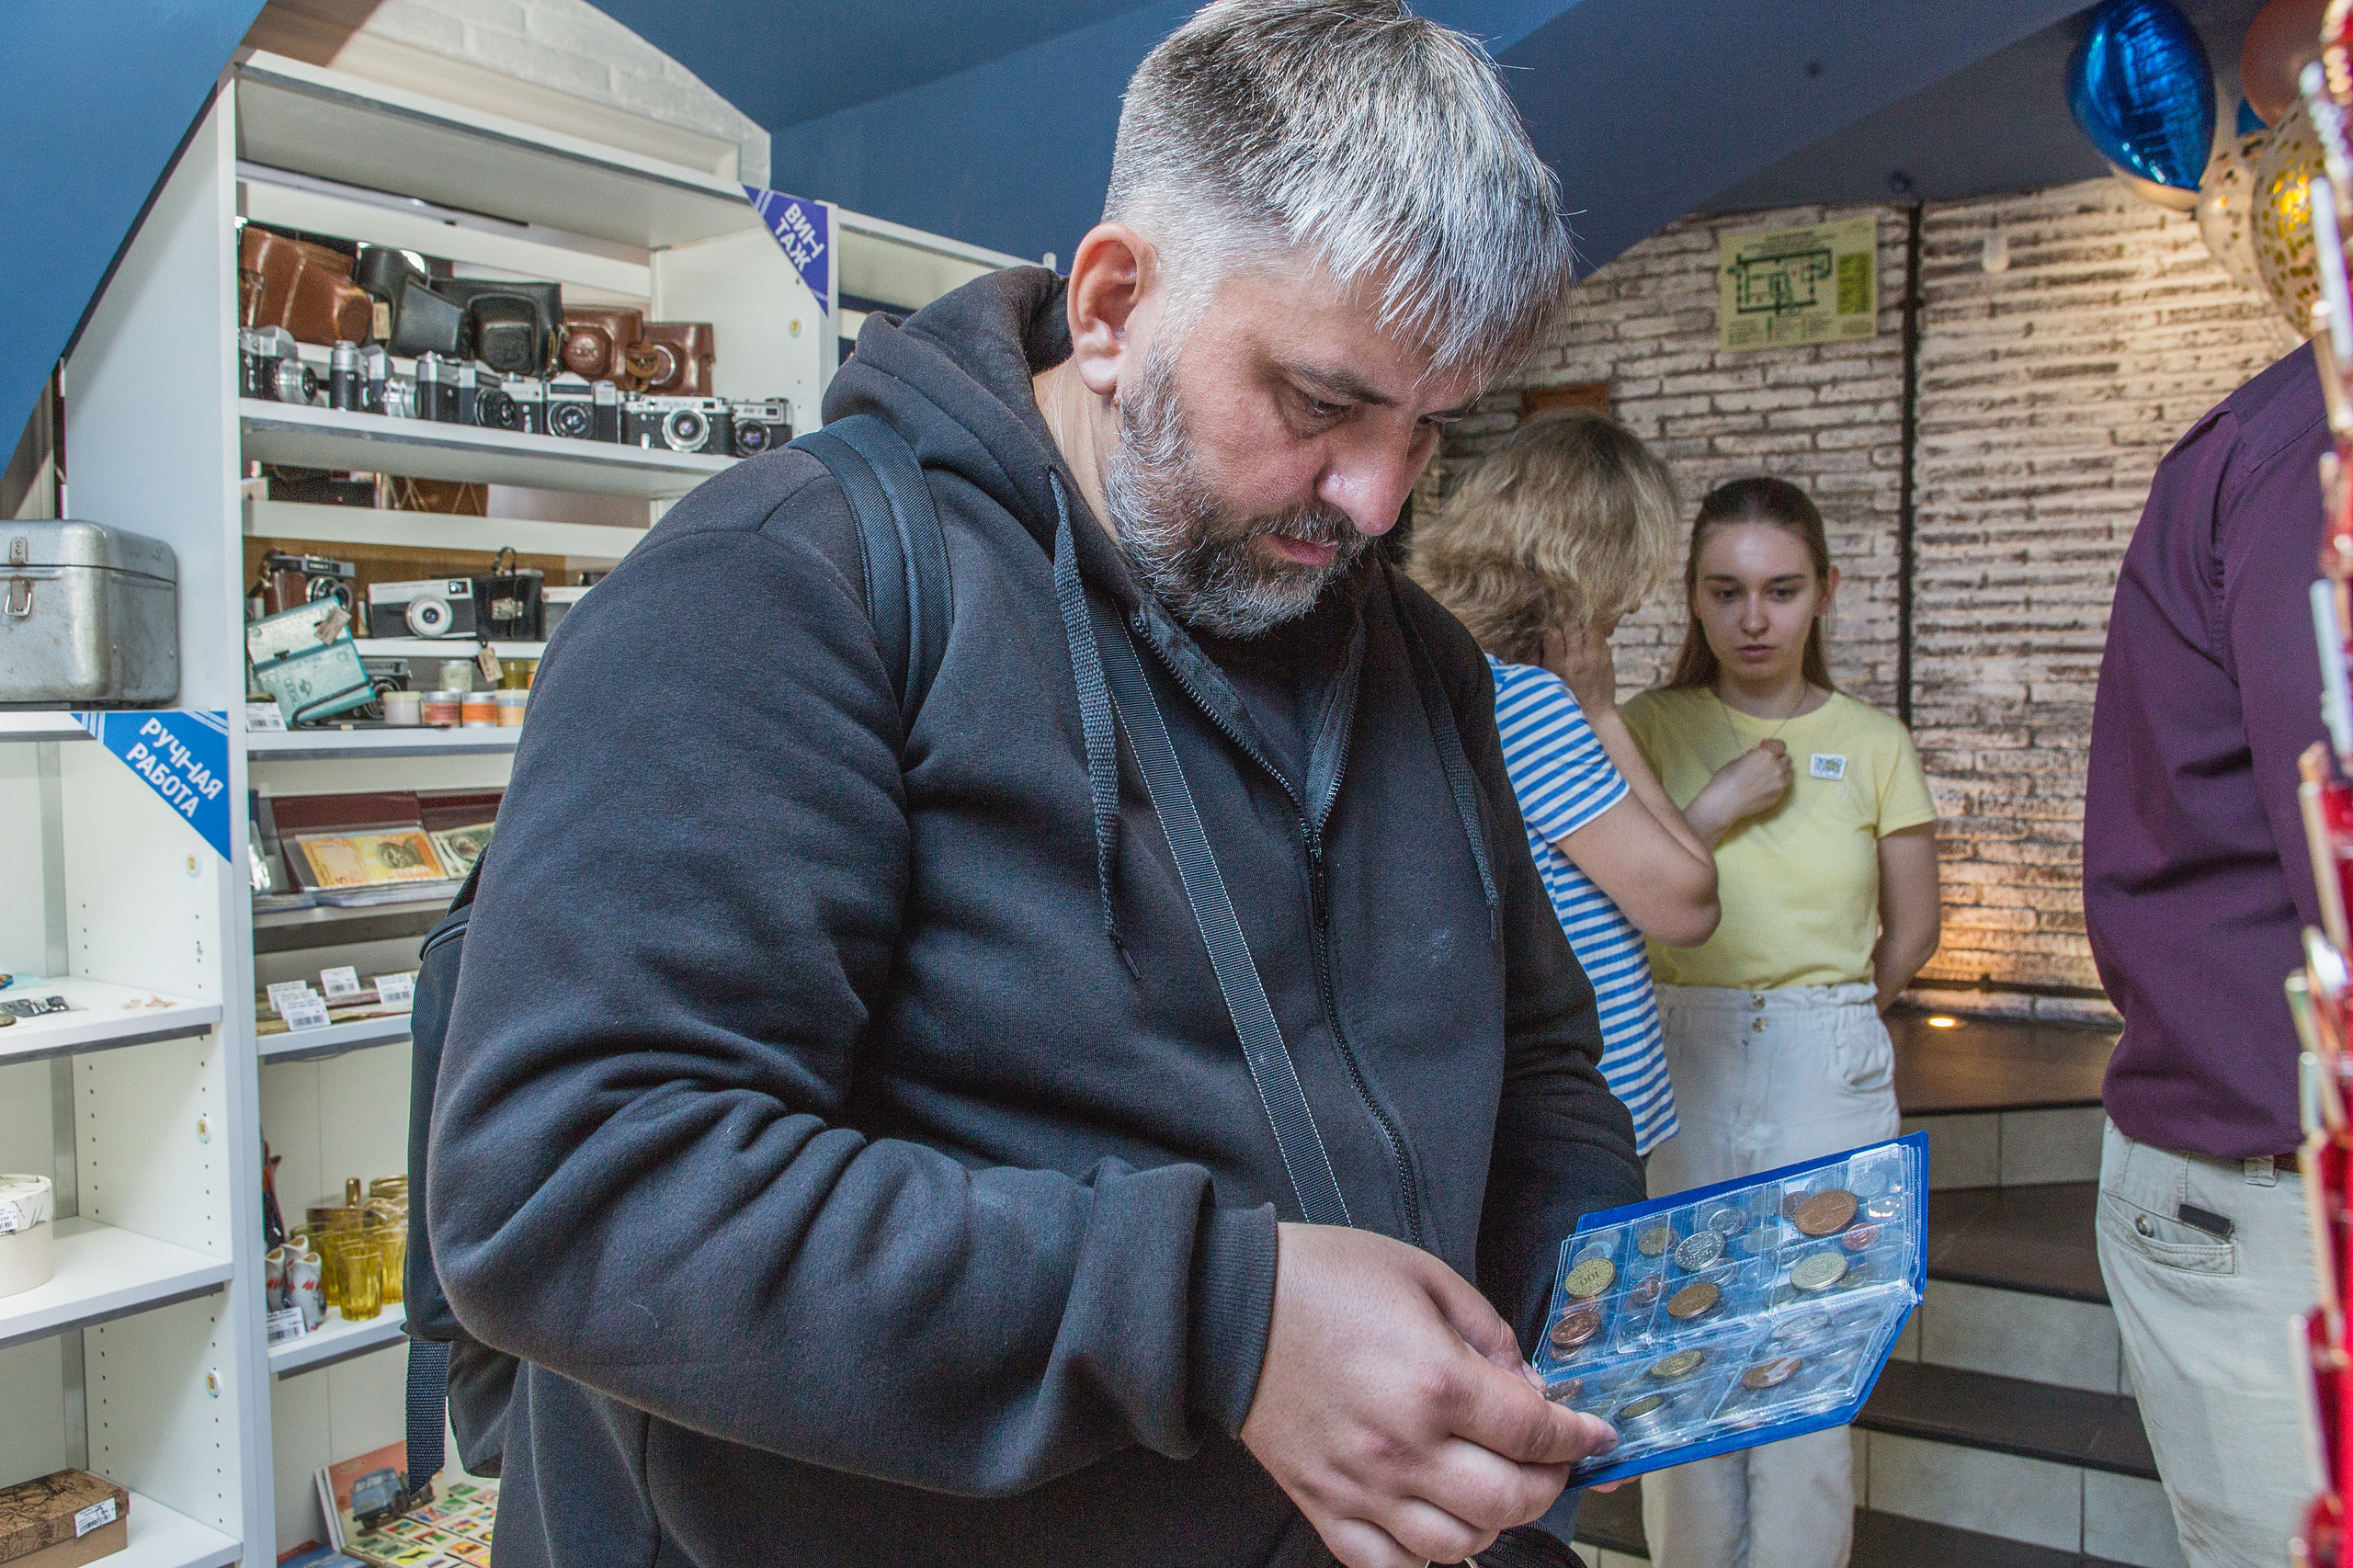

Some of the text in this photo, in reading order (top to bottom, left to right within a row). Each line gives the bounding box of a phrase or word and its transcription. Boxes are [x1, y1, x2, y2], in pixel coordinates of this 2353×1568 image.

[775, 216, 812, 272] ТАЖ
[784, 202, 824, 258] ВИН
[125, 742, 199, 818] РАБОТА
[139, 717, 224, 801] РУЧНАЯ
[1579, 1269, 1600, 1287] 100
